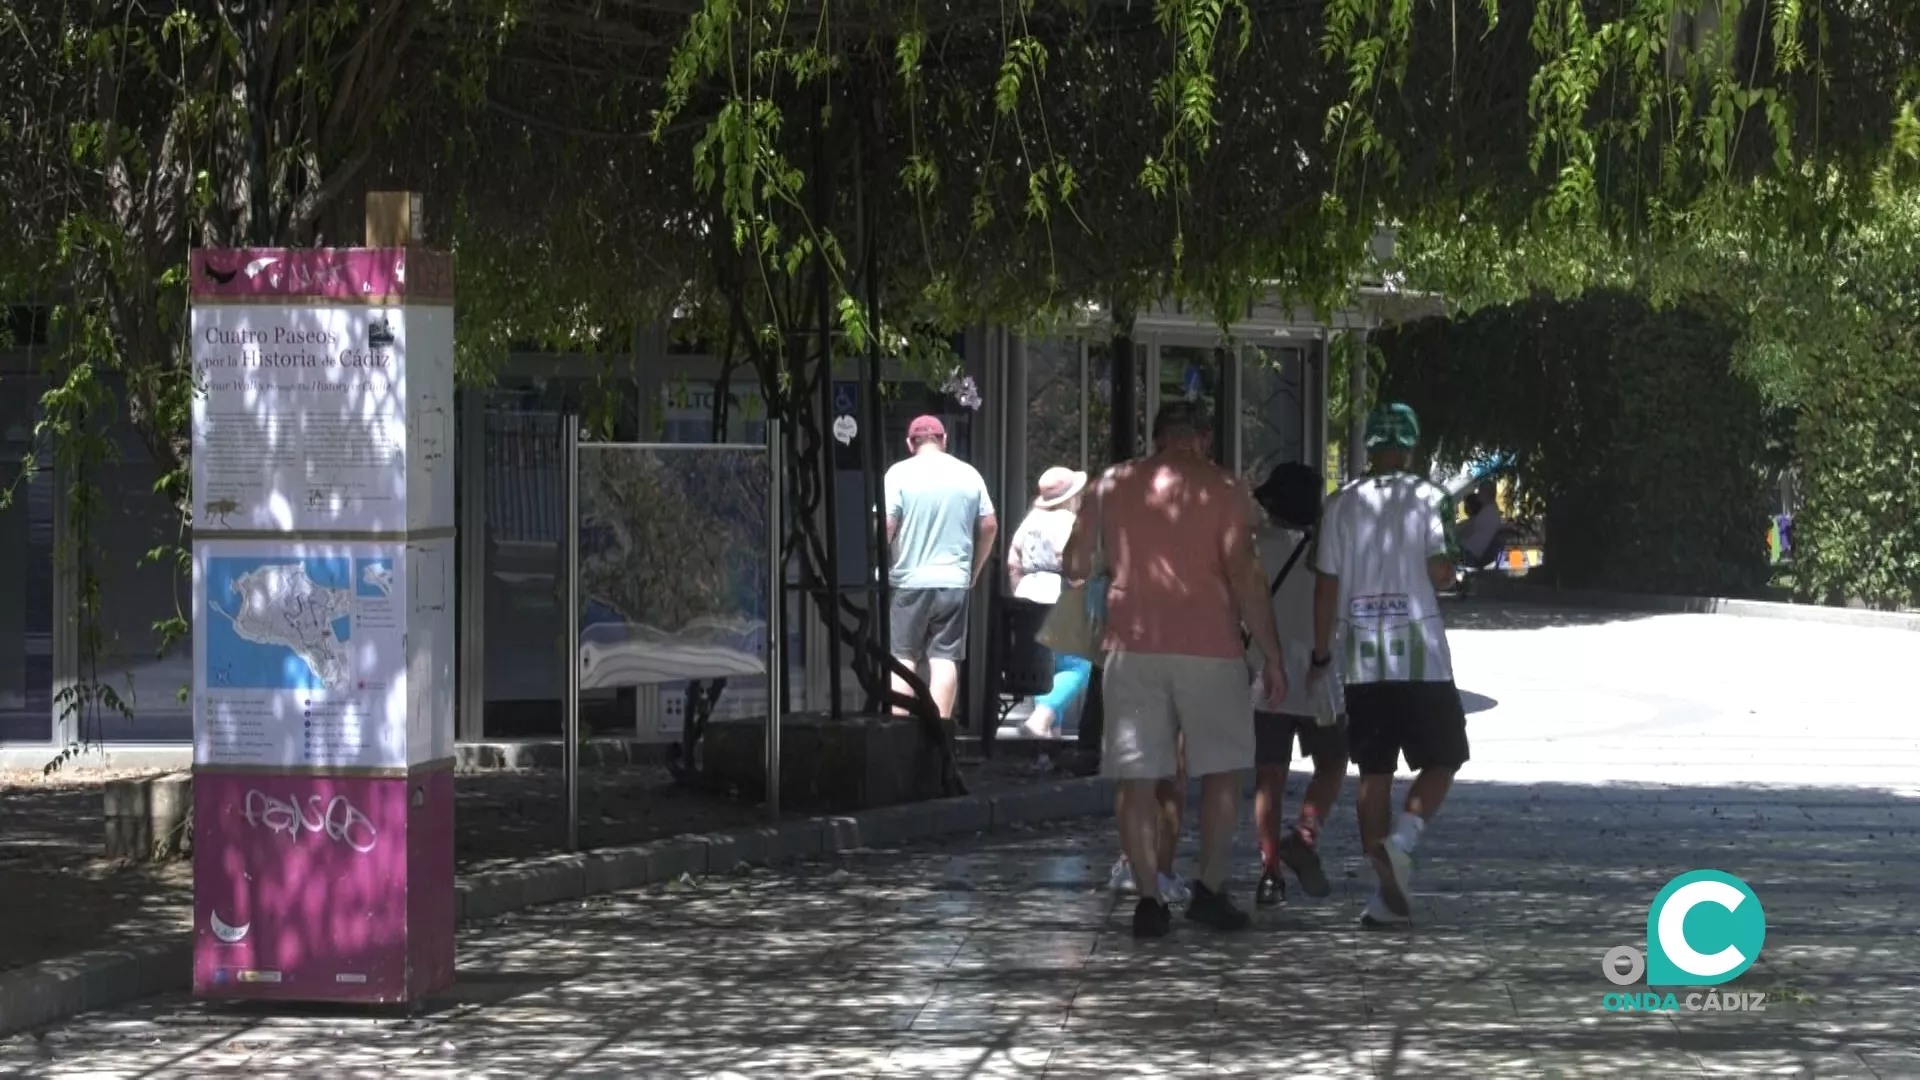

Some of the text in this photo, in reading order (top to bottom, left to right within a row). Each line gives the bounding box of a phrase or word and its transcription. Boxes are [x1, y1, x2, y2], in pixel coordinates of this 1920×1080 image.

[205, 326, 336, 345] Cuatro Paseos
[205, 348, 391, 368] por la Historia de Cádiz
